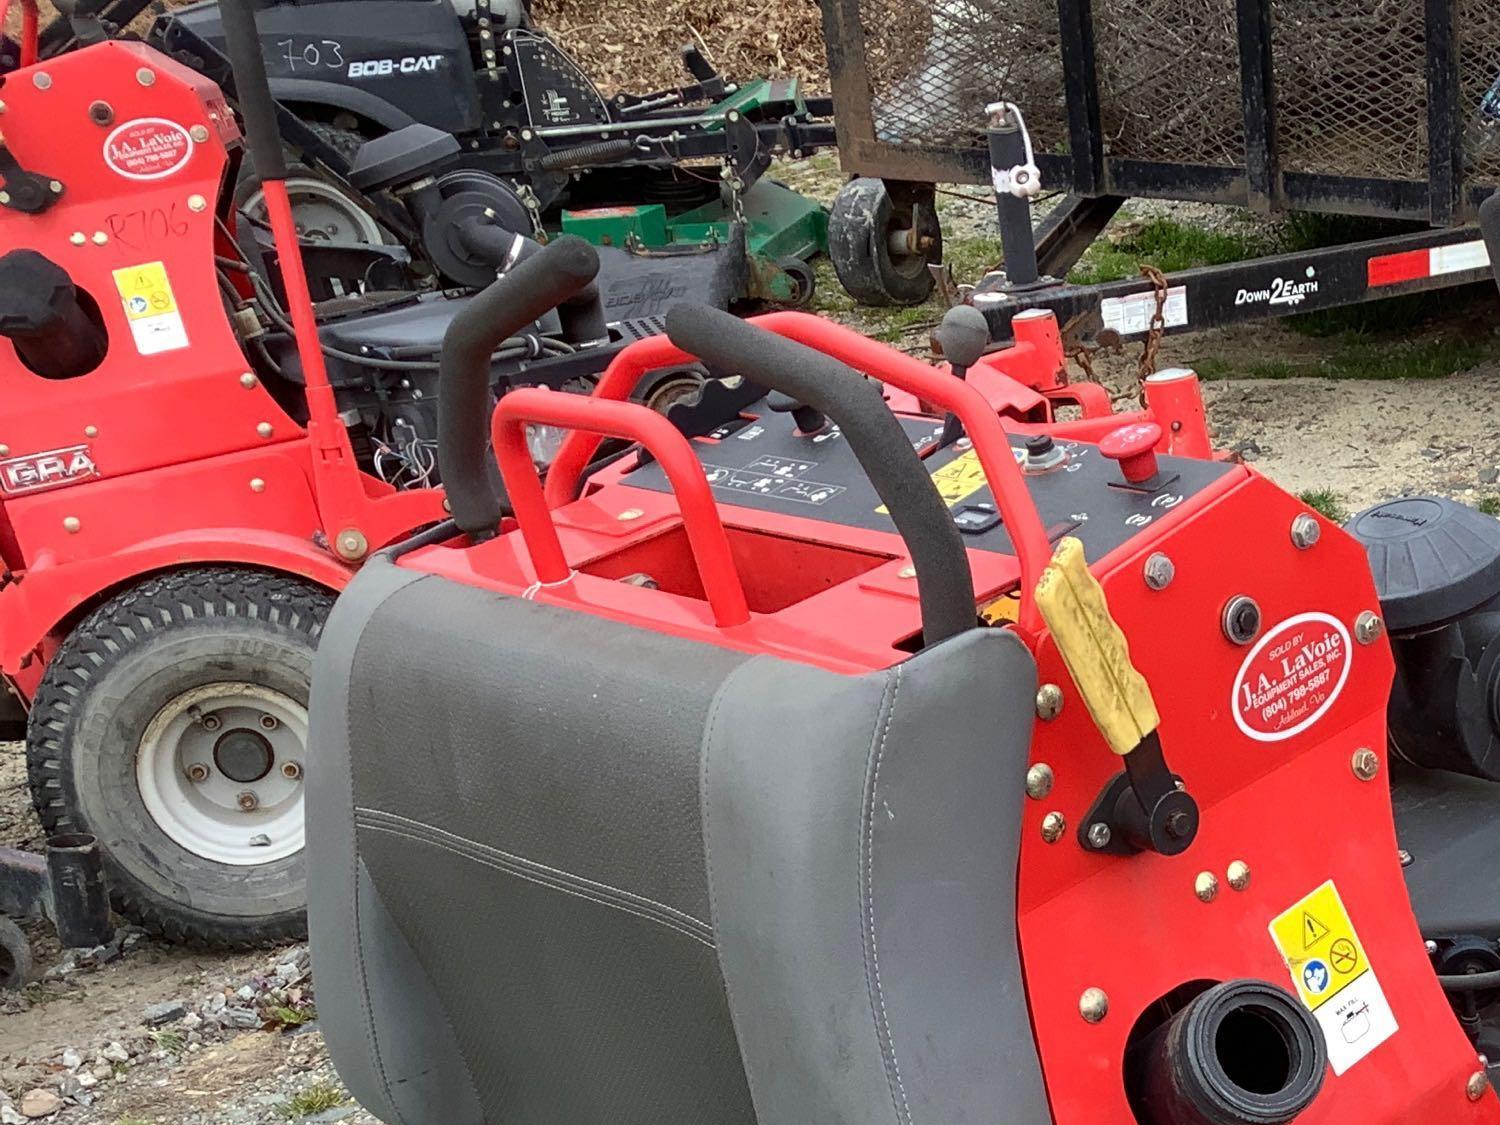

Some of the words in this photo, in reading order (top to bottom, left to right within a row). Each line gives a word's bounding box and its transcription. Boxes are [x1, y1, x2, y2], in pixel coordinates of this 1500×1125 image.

[348, 54, 444, 78] BOB-CAT
[1268, 640, 1292, 661] SOLD
[1292, 632, 1305, 647] BY
[1242, 672, 1277, 711] J.A.
[1281, 632, 1340, 679] LaVoie
[1253, 673, 1297, 709] EQUIPMENT
[1326, 649, 1343, 663] INC.
[1262, 696, 1288, 722] (804)
